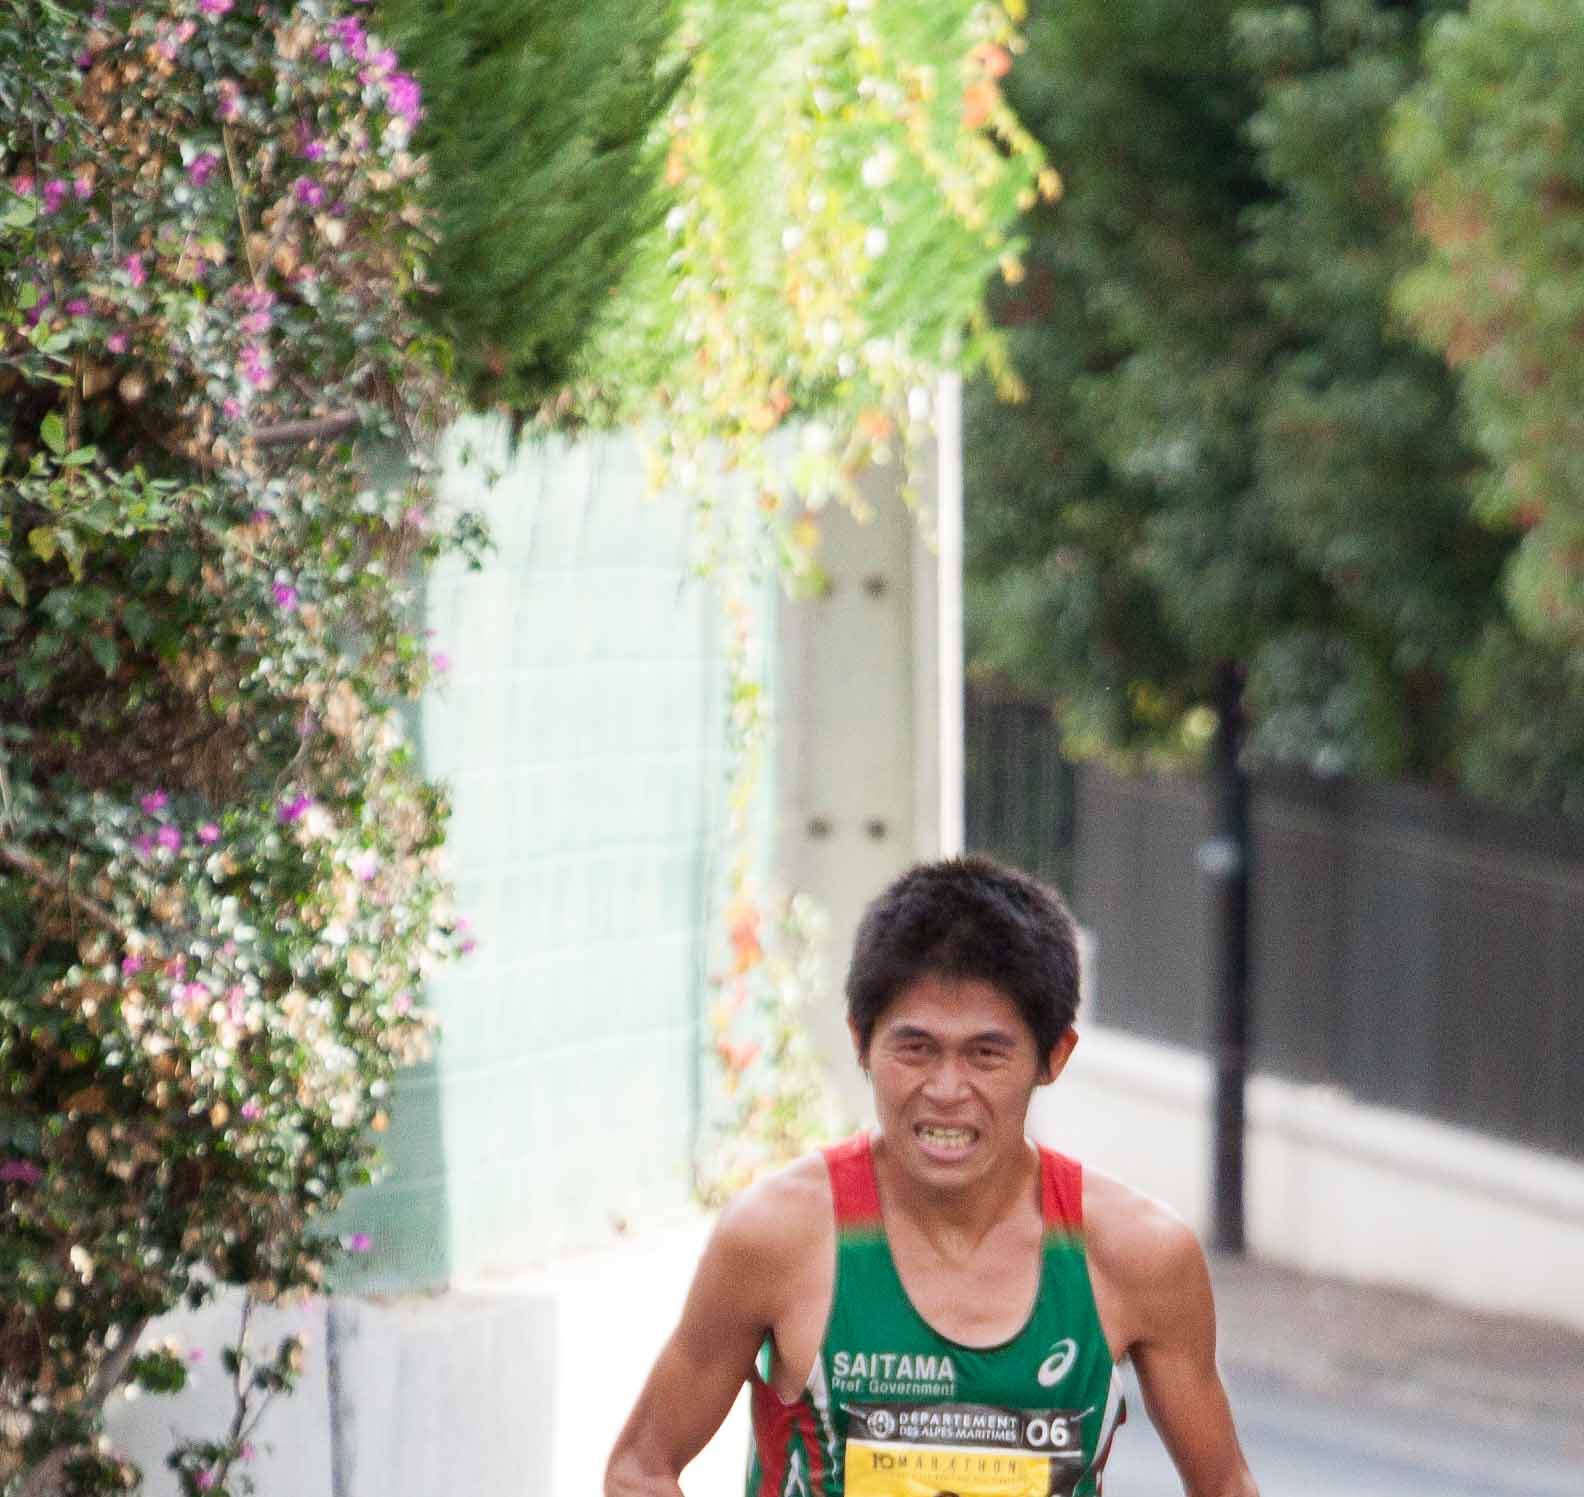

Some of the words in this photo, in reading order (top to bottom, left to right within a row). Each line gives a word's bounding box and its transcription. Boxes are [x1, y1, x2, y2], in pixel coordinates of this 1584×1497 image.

[833, 1351, 955, 1381] SAITAMA
[869, 1379, 955, 1396] Government
[1026, 1418, 1070, 1447] 06
